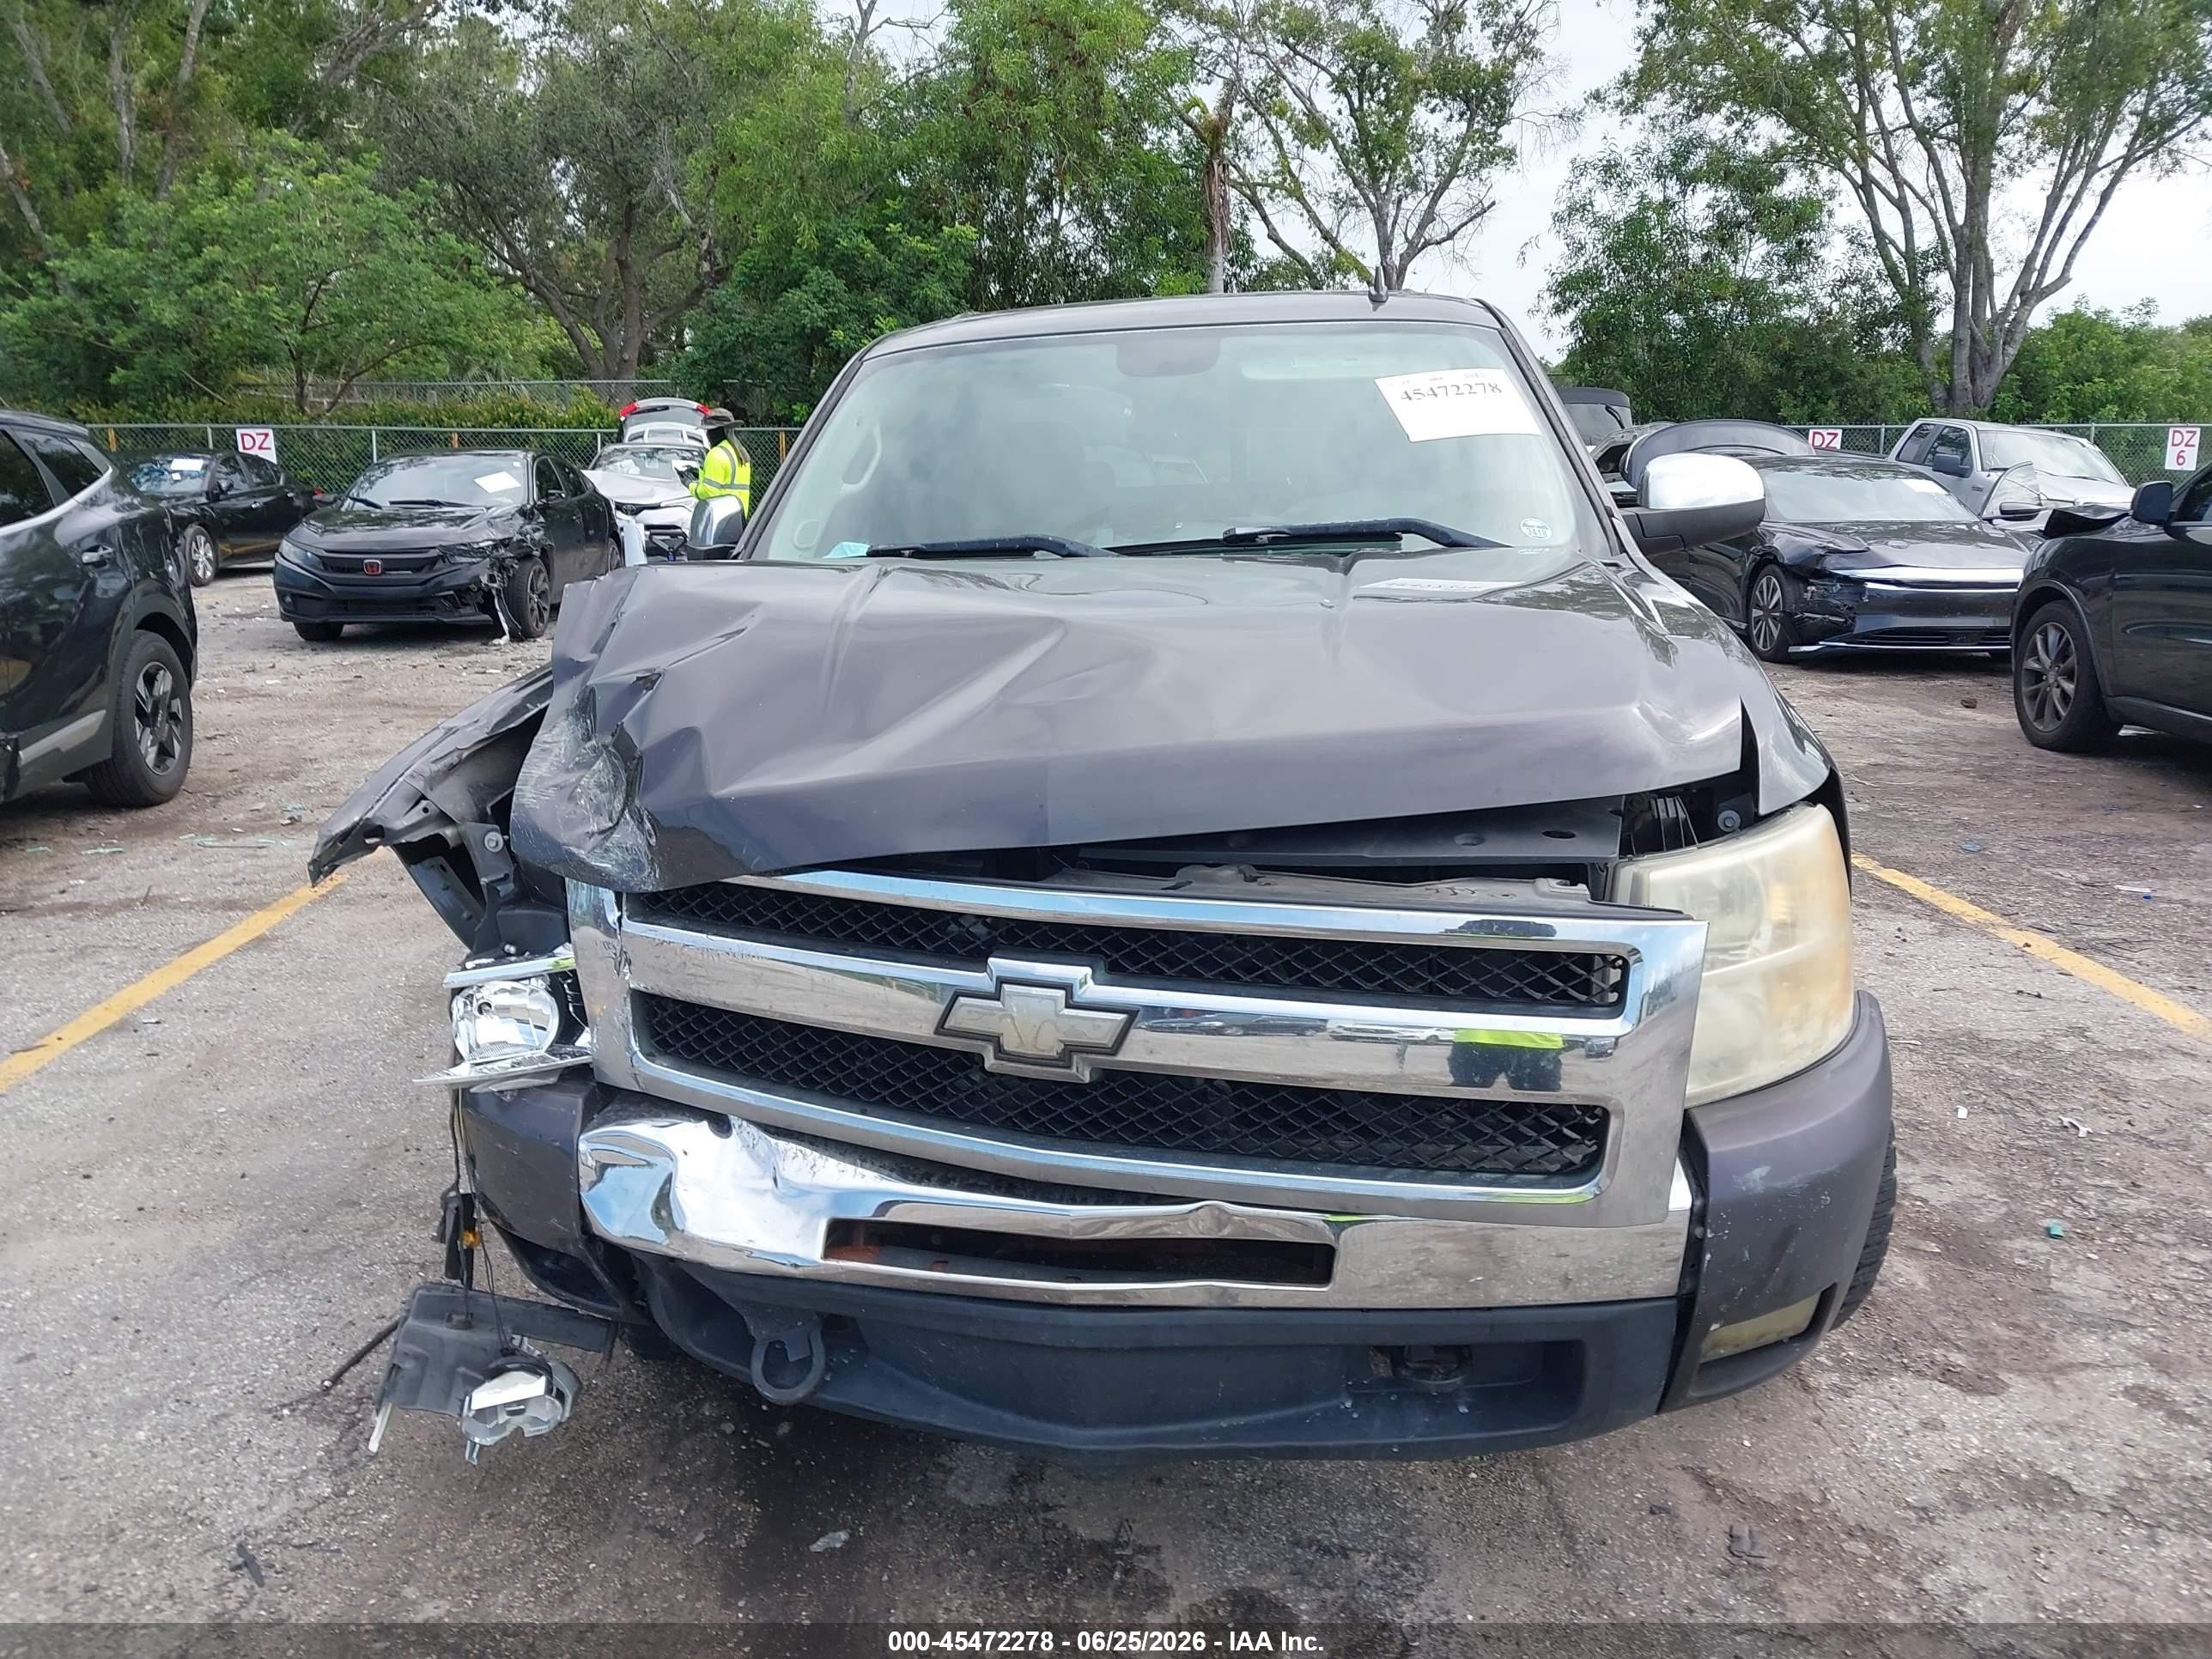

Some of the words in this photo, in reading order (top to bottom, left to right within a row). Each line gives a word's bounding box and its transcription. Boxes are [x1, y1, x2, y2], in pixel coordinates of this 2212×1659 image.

[1401, 382, 1503, 401] 45472278
[240, 432, 271, 451] DZ
[1812, 431, 1838, 449] DZ
[2172, 429, 2197, 448] DZ
[2176, 449, 2186, 466] 6
